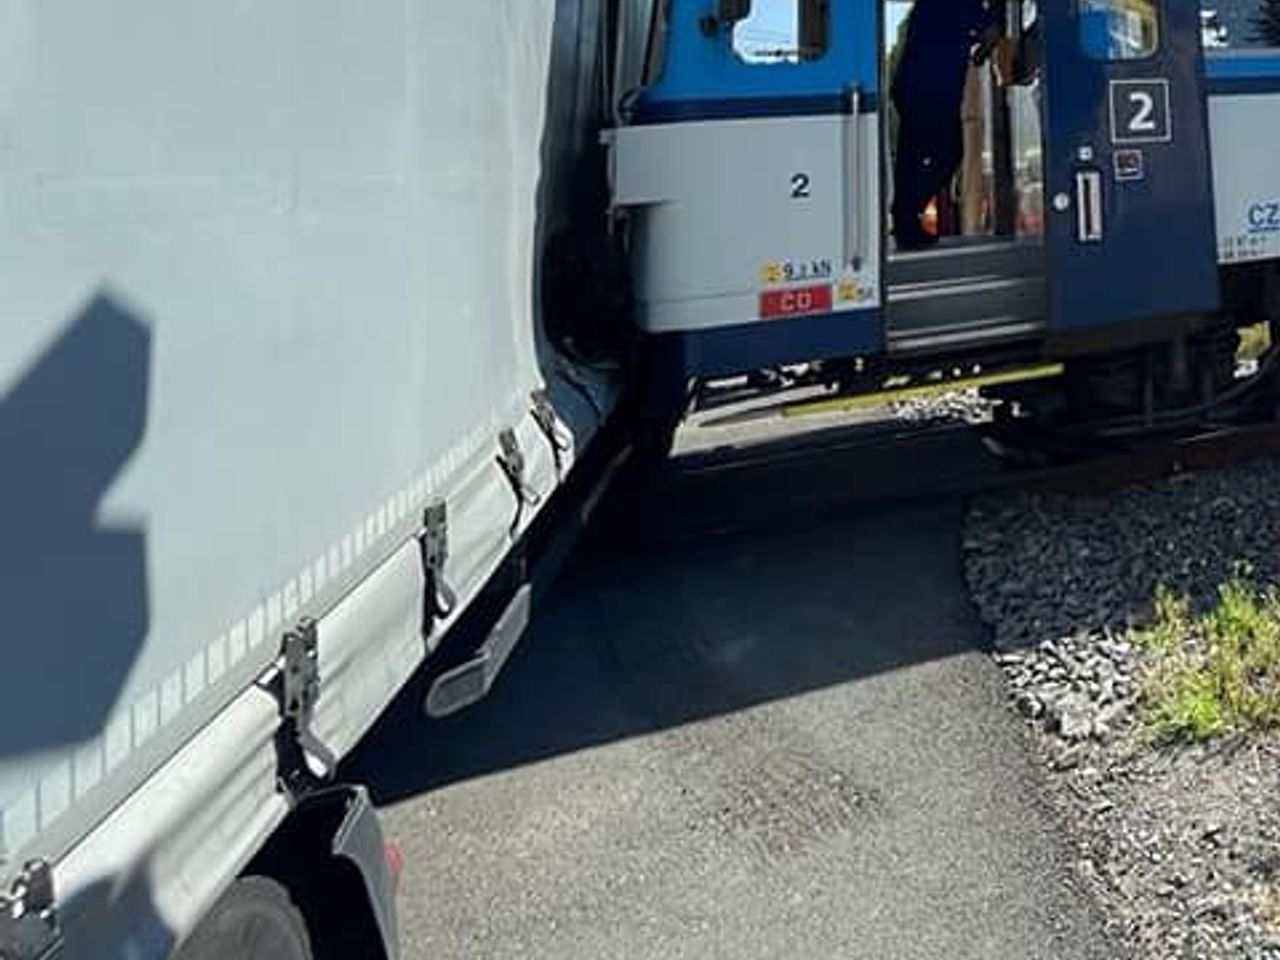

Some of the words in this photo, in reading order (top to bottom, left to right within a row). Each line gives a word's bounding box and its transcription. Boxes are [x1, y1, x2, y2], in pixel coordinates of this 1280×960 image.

[1128, 92, 1155, 130] 2
[791, 173, 810, 198] 2
[1247, 202, 1280, 228] CZ
